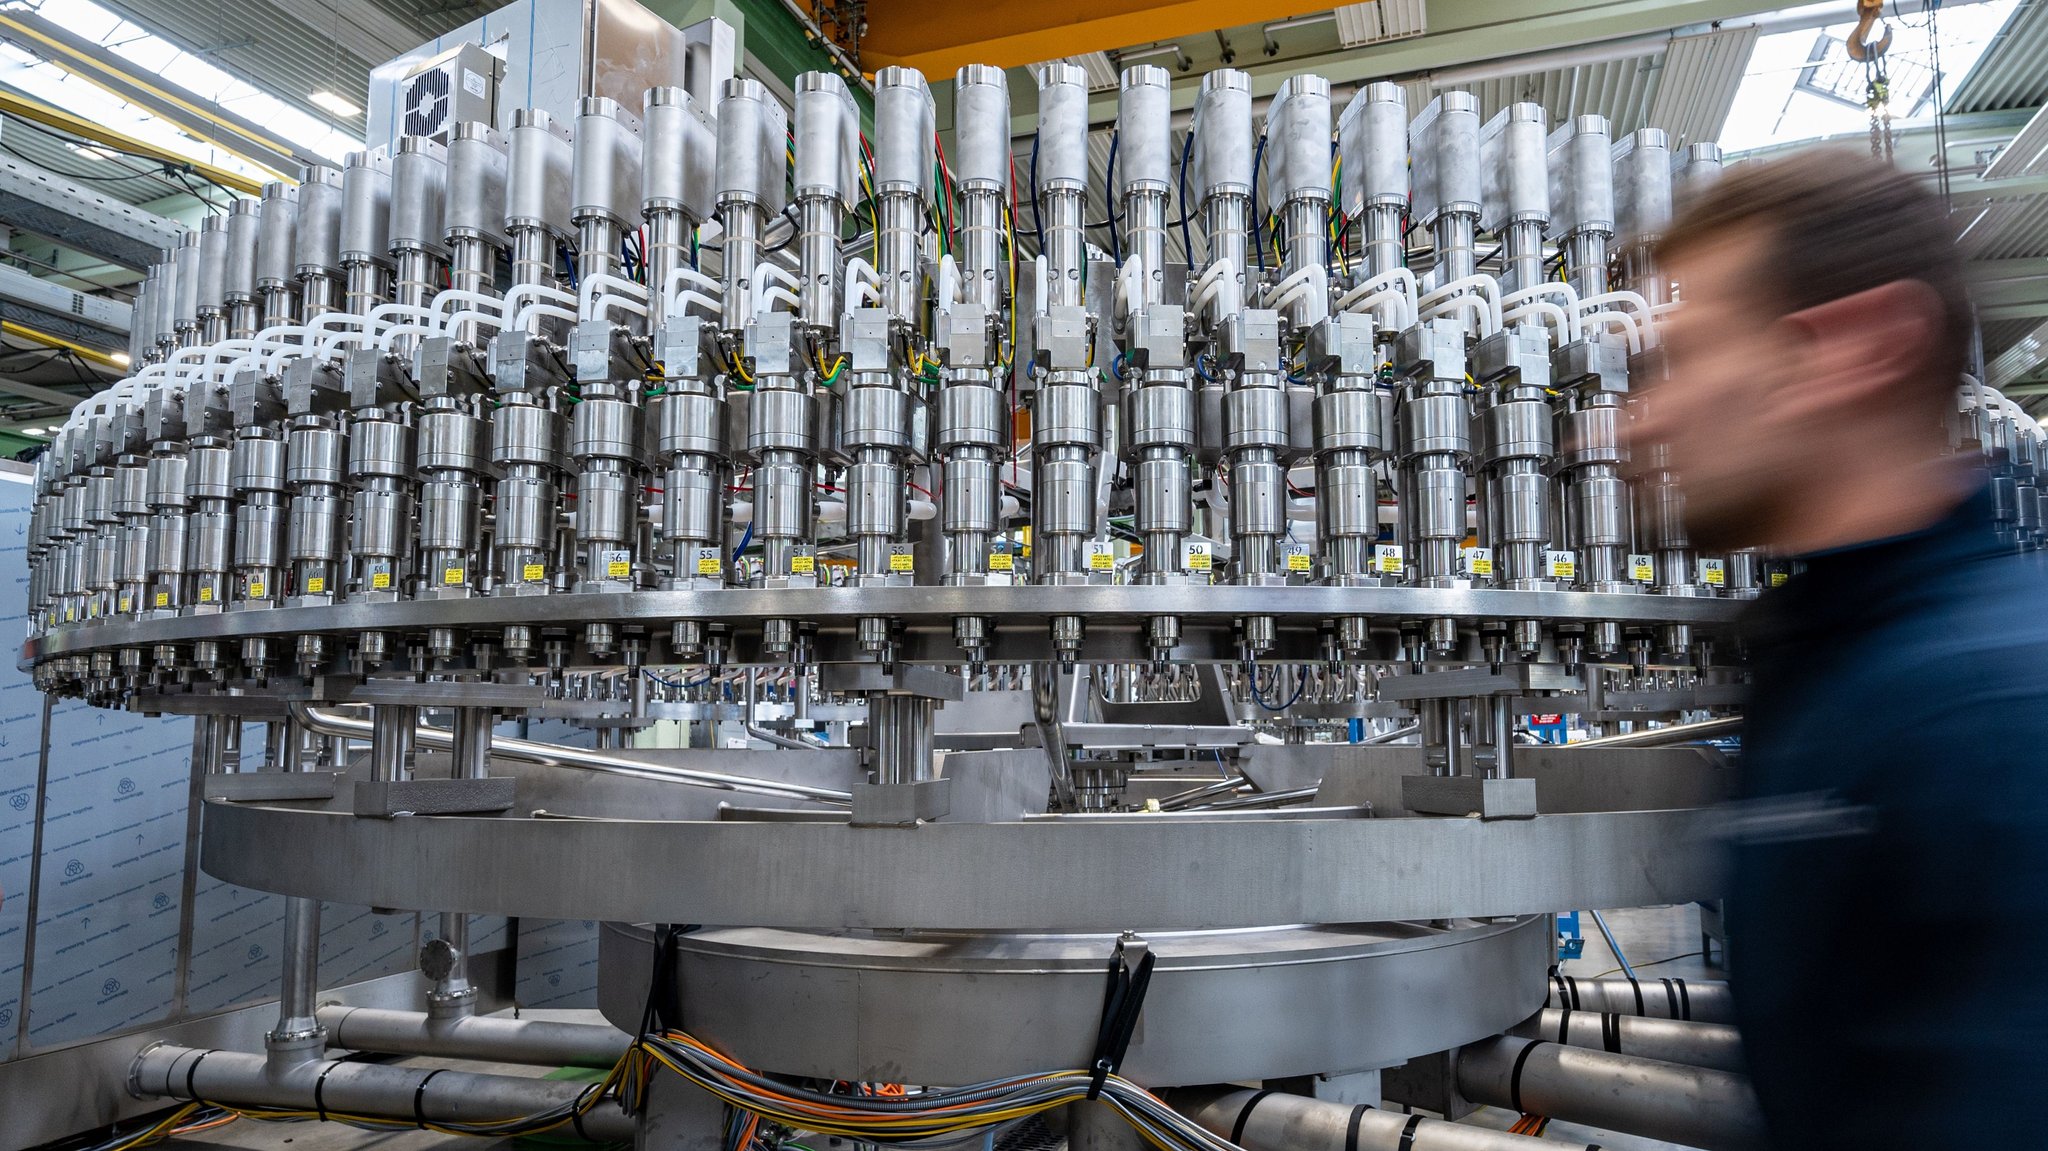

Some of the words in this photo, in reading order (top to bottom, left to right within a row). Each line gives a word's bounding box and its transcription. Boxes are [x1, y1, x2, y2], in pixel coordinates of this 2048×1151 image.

[891, 546, 905, 555] 53
[1093, 545, 1104, 554] 51
[1189, 545, 1203, 554] 50
[1288, 546, 1302, 555] 49
[1382, 548, 1395, 557] 48
[609, 553, 622, 562] 56
[699, 550, 713, 559] 55
[1473, 551, 1485, 560] 47
[1553, 554, 1567, 562] 46
[1635, 557, 1646, 566] 45
[1706, 562, 1717, 570] 44
[374, 565, 384, 573] 59
